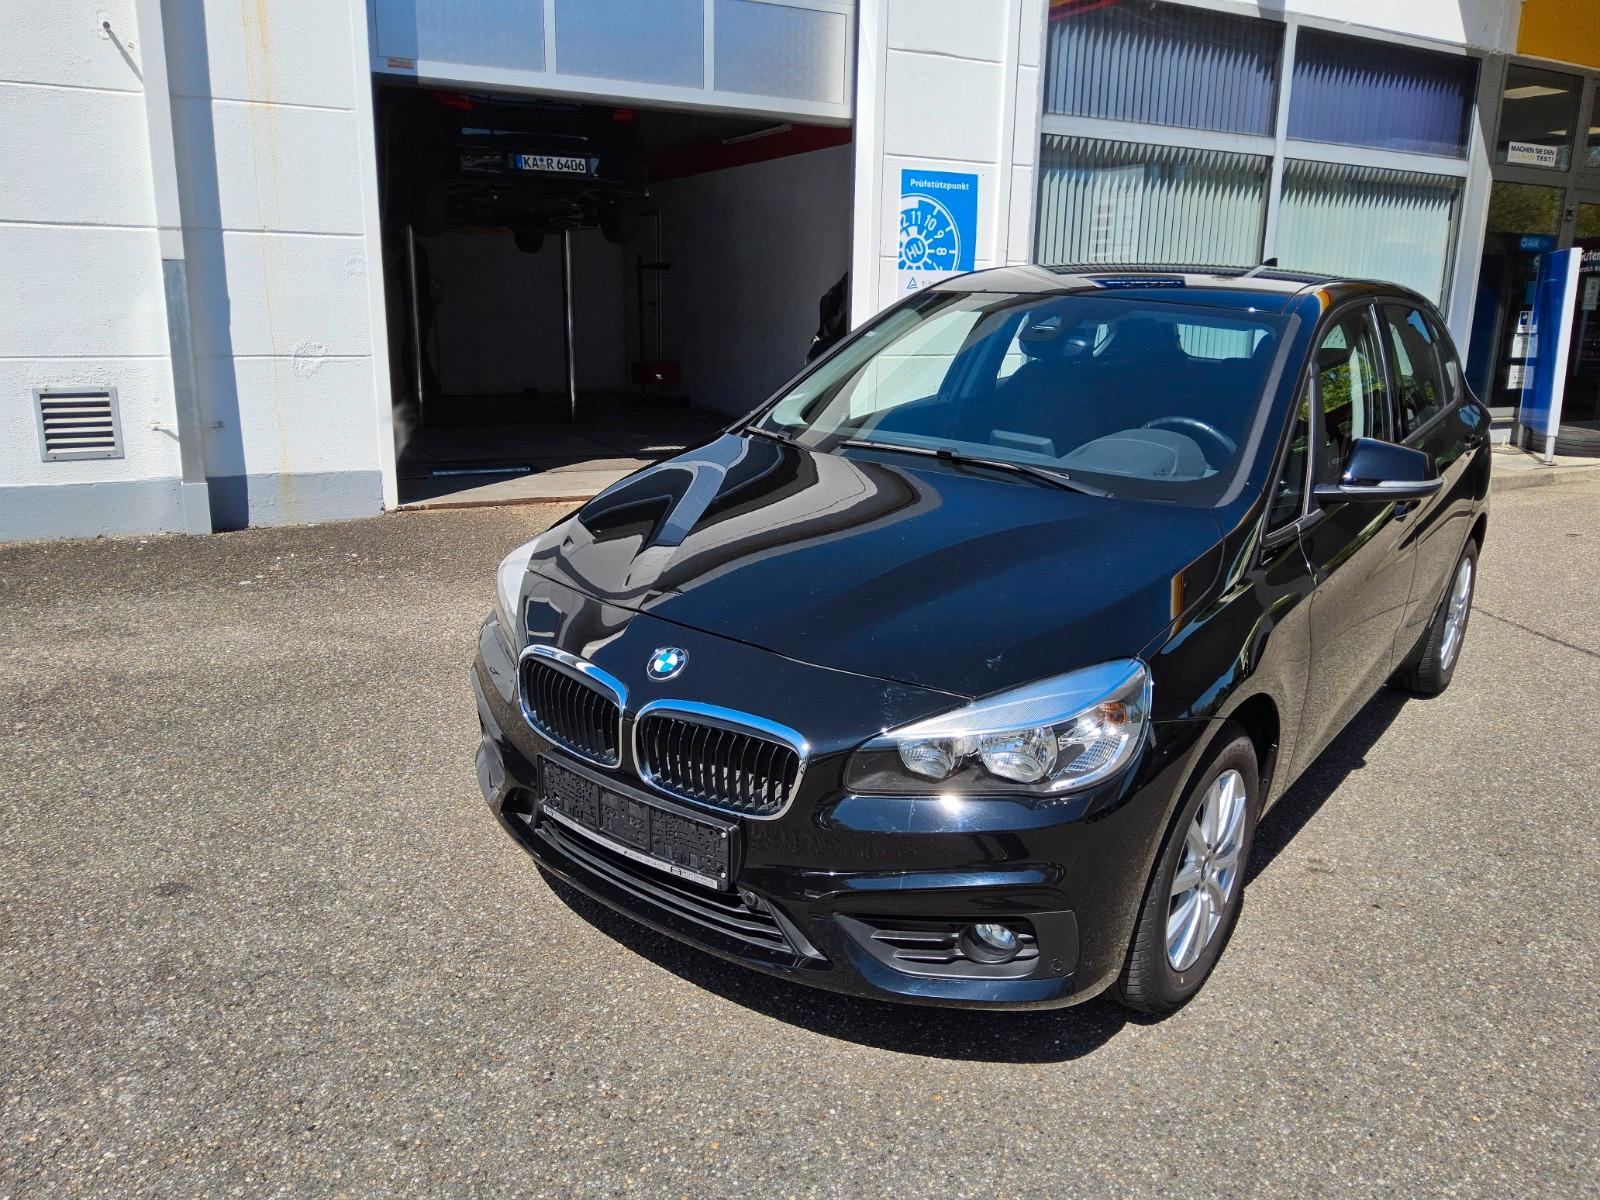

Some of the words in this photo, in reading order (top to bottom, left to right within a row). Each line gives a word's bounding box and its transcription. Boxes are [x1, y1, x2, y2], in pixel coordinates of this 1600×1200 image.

[523, 157, 539, 169] KA
[546, 158, 554, 169] R
[557, 159, 585, 171] 6406
[910, 178, 970, 191] Prüfstützpunkt
[911, 210, 921, 224] 11
[924, 214, 937, 231] 10
